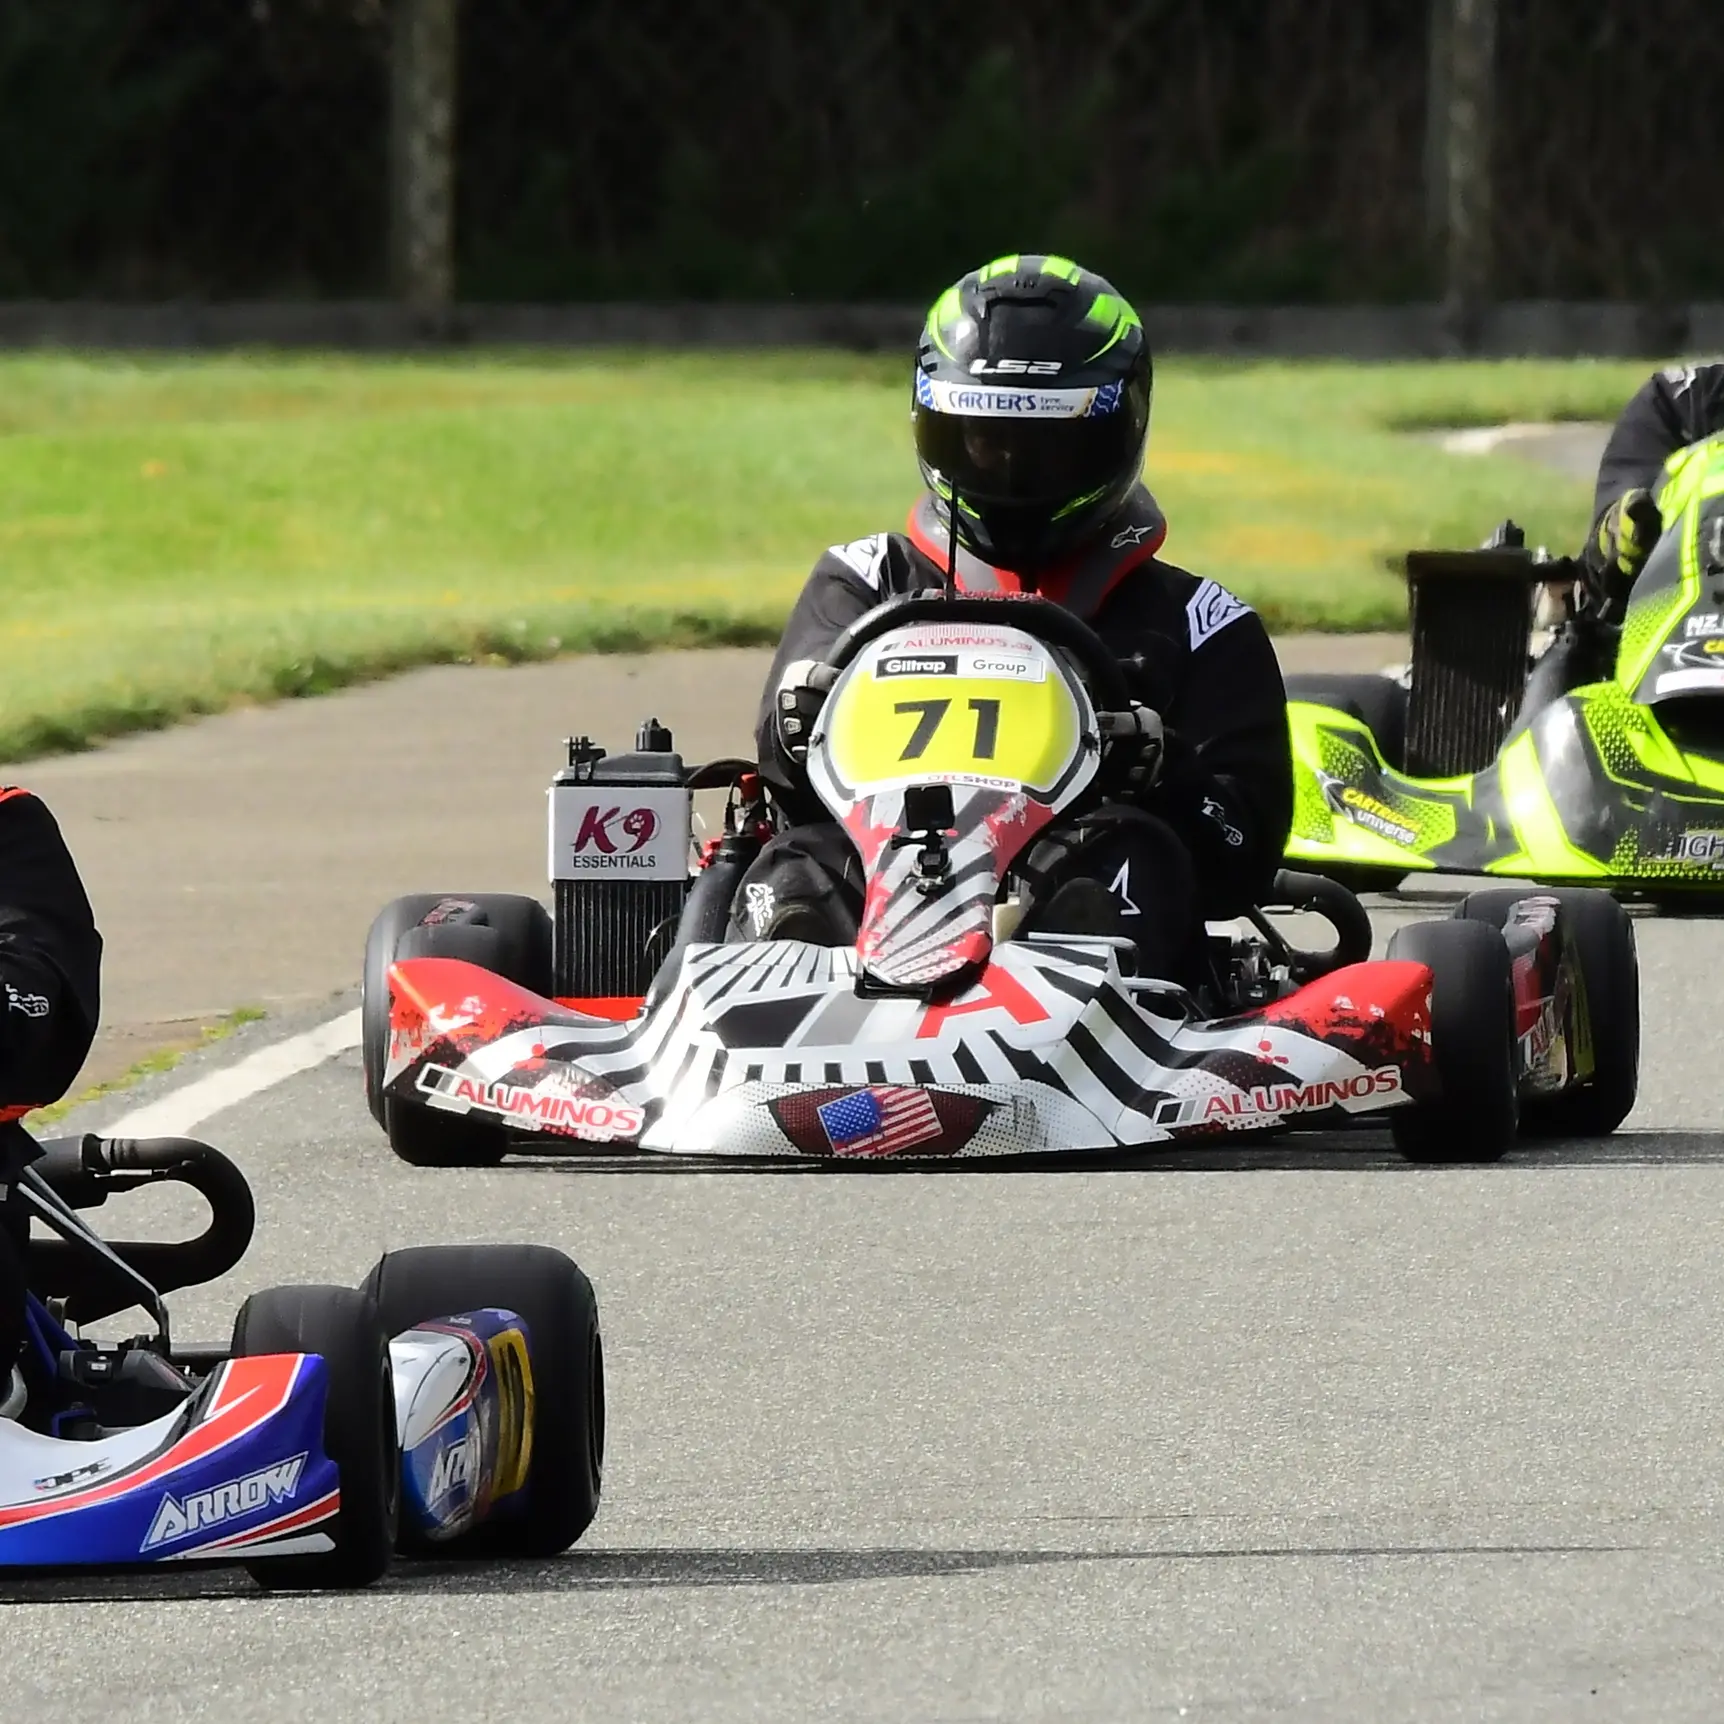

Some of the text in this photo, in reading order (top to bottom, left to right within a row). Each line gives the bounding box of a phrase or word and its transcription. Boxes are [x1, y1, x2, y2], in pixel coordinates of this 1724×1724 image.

[969, 359, 1062, 374] LS2
[949, 390, 1036, 412] CARTER'S
[885, 659, 1027, 675] Giltrap Group
[894, 698, 1001, 761] 71
[574, 805, 656, 854] K9
[1357, 810, 1416, 844] universe
[573, 855, 656, 868] ESSENTIALS
[455, 1079, 639, 1131] ALUMINOS
[1203, 1069, 1399, 1118] ALUMINOS
[143, 1454, 305, 1549] ARROW
